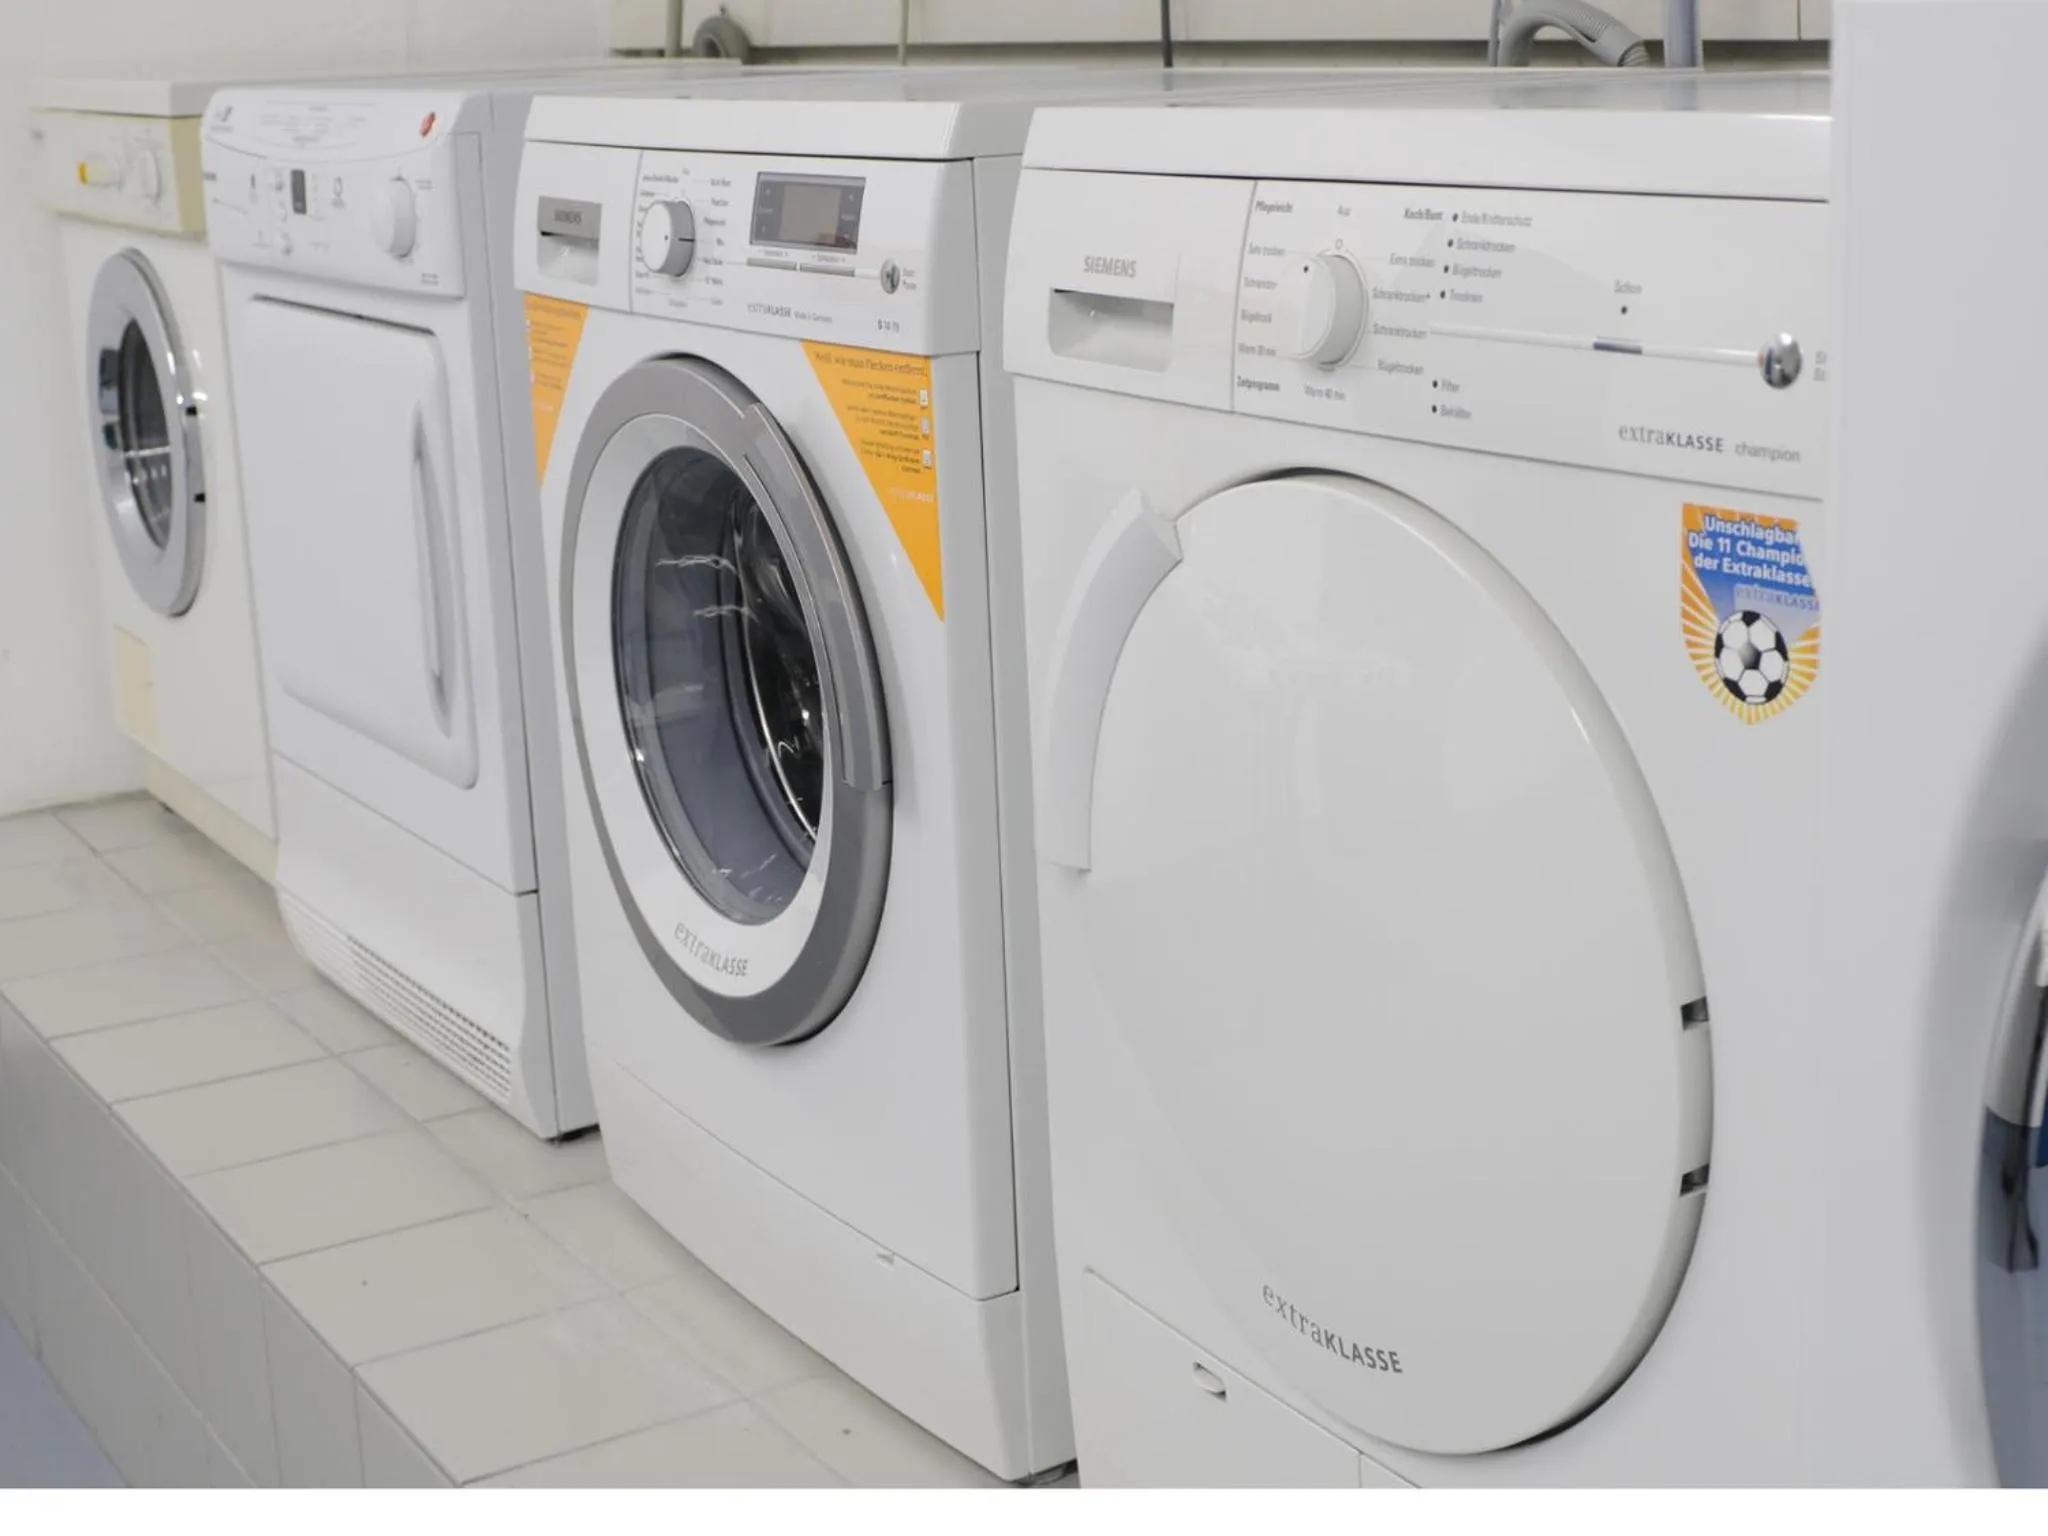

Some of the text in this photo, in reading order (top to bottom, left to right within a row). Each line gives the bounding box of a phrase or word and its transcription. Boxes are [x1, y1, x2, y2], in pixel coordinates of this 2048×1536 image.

[1083, 255, 1138, 279] SIEMENS
[1618, 423, 1802, 463] extraKLASSE champion
[1688, 531, 1714, 551] Die
[1717, 536, 1731, 554] 11
[1693, 551, 1720, 570] der
[674, 921, 749, 977] extraKLASSE
[1262, 1284, 1404, 1374] extraKLASSE
